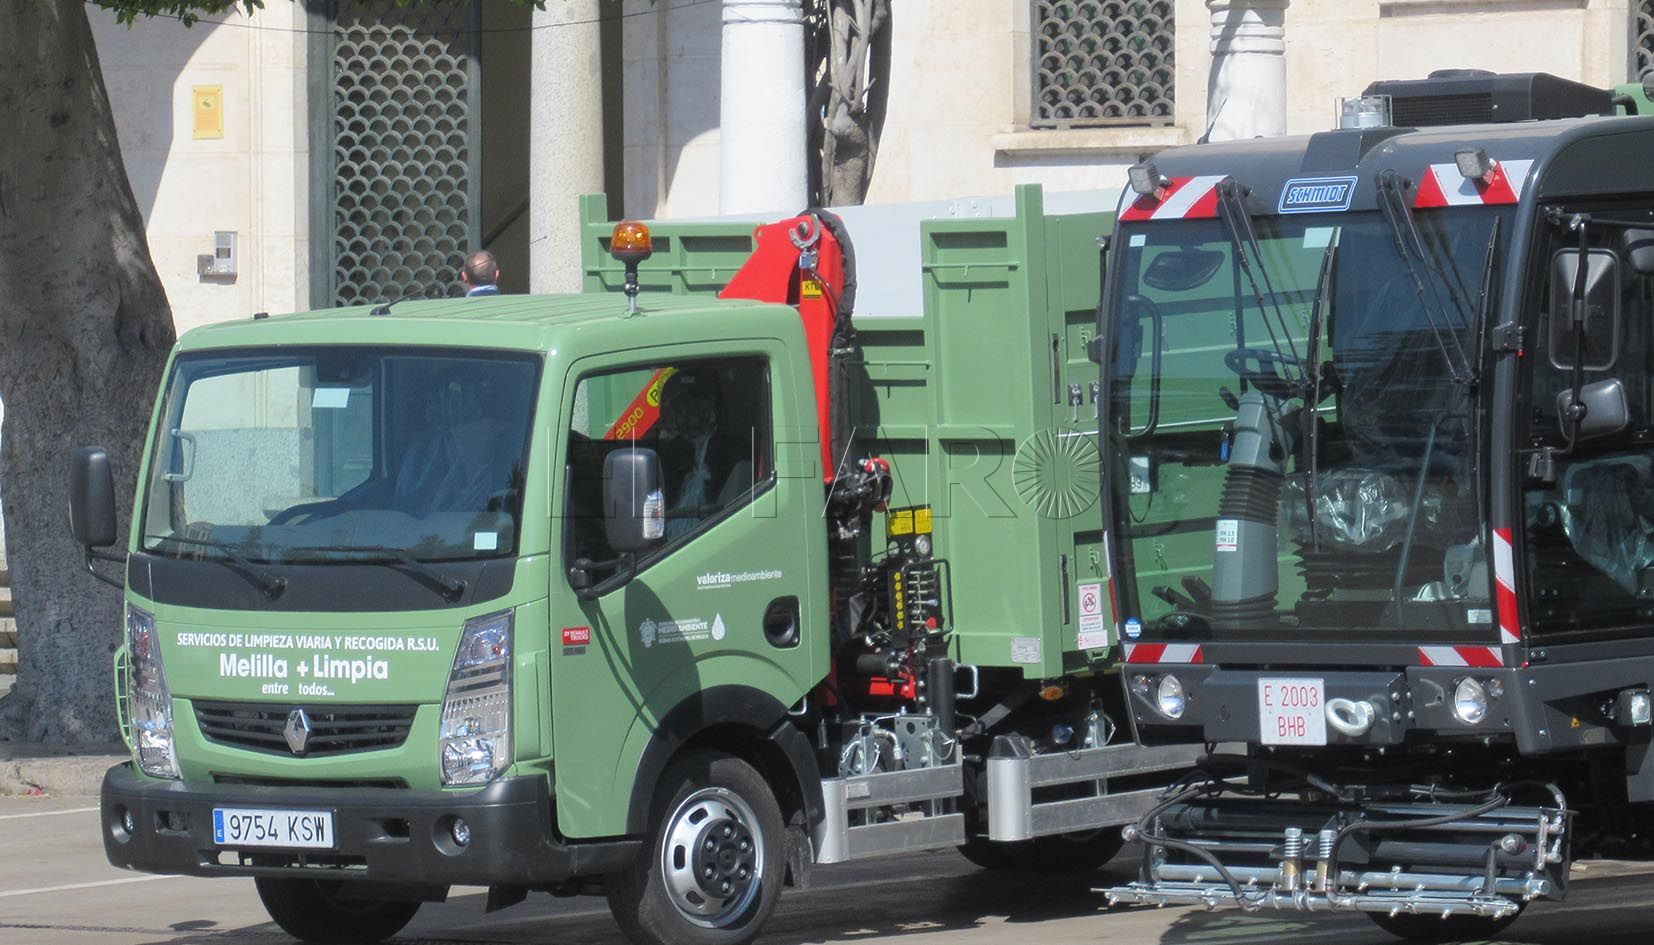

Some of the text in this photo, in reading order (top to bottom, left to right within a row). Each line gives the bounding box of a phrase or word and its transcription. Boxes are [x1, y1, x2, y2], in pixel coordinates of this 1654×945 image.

[1286, 185, 1348, 204] SCHMIDT
[615, 407, 645, 440] 2900
[177, 632, 439, 651] SERVICIOS DE LIMPIEZA VIARIA Y RECOGIDA R.S.U.
[219, 653, 288, 678] Melilla
[262, 682, 289, 694] entre
[1264, 685, 1318, 707] E 2003
[1278, 716, 1306, 737] BHB
[230, 815, 325, 841] 9754 KSW
